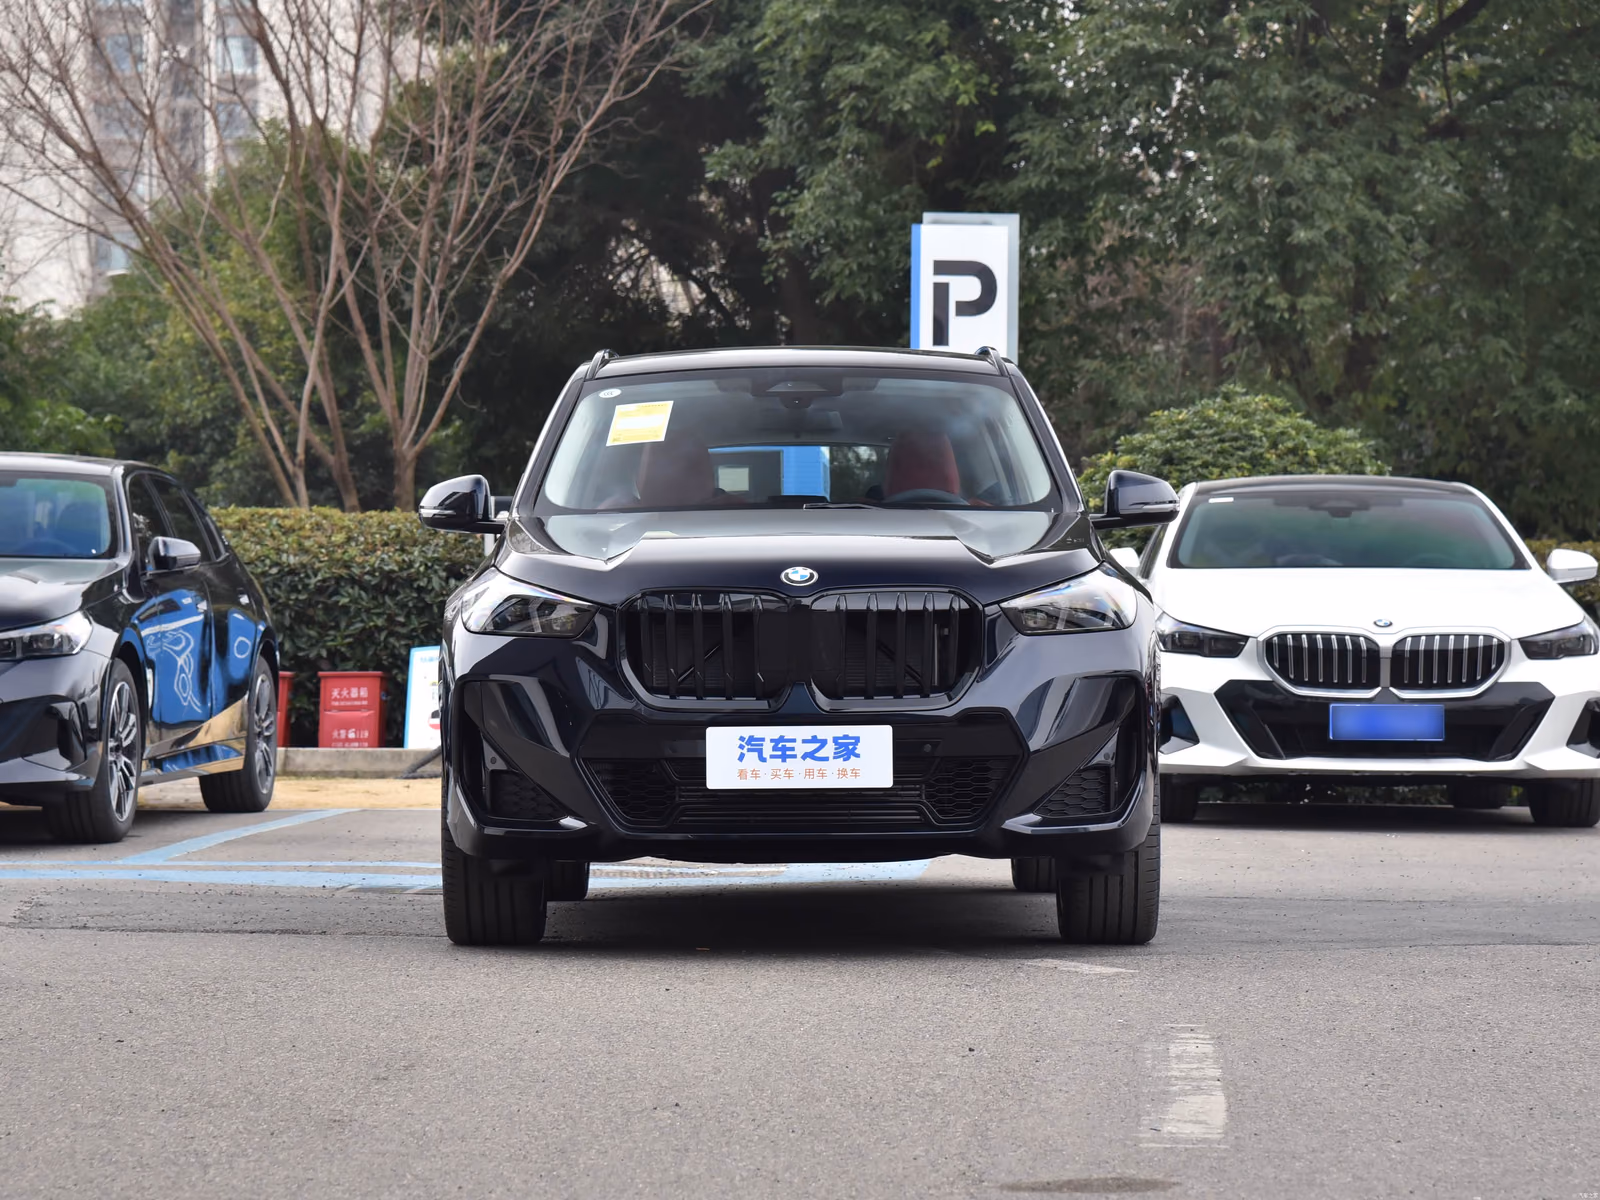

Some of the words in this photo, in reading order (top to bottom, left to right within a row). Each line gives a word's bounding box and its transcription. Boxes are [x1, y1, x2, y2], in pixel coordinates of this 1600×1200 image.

[932, 260, 998, 346] P
[737, 734, 861, 763] 汽车之家
